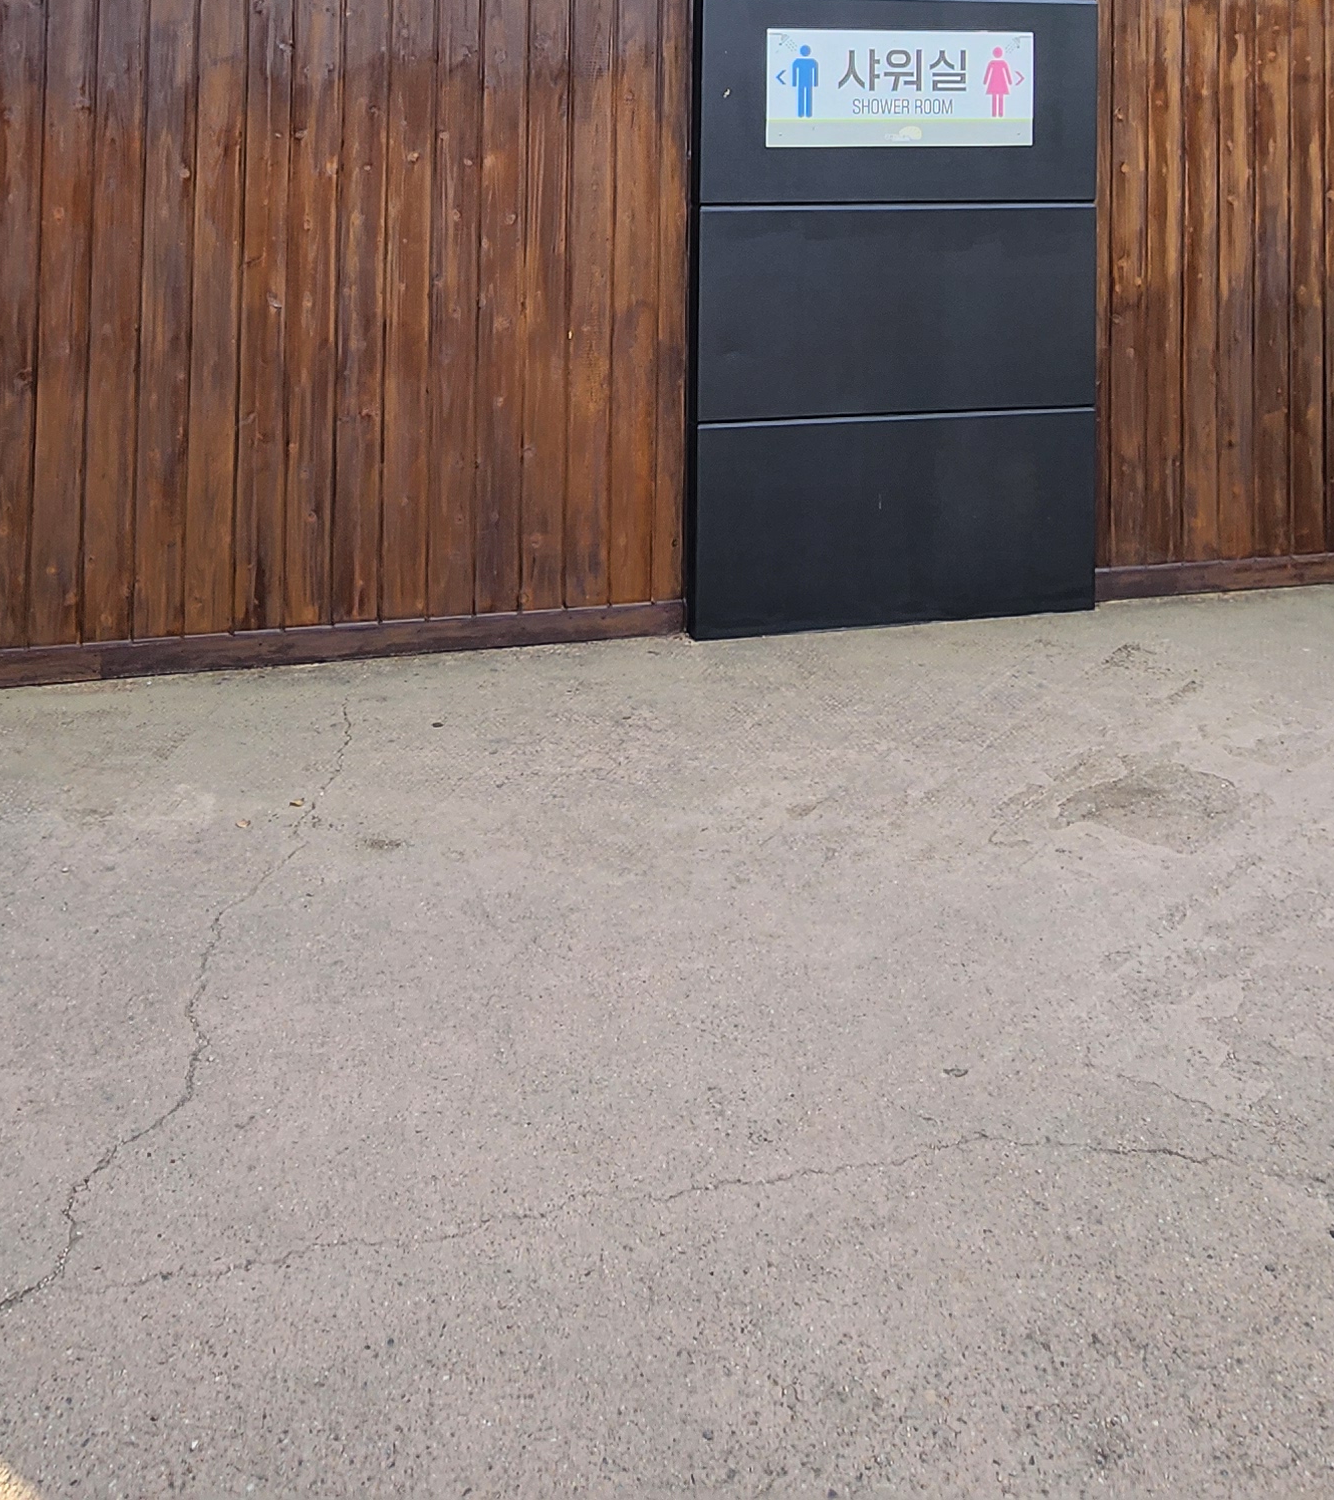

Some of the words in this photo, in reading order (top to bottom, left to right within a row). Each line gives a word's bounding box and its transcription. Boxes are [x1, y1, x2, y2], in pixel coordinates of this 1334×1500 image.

[838, 48, 967, 92] 샤워실
[852, 98, 910, 115] SHOWER
[914, 98, 954, 115] ROOM
